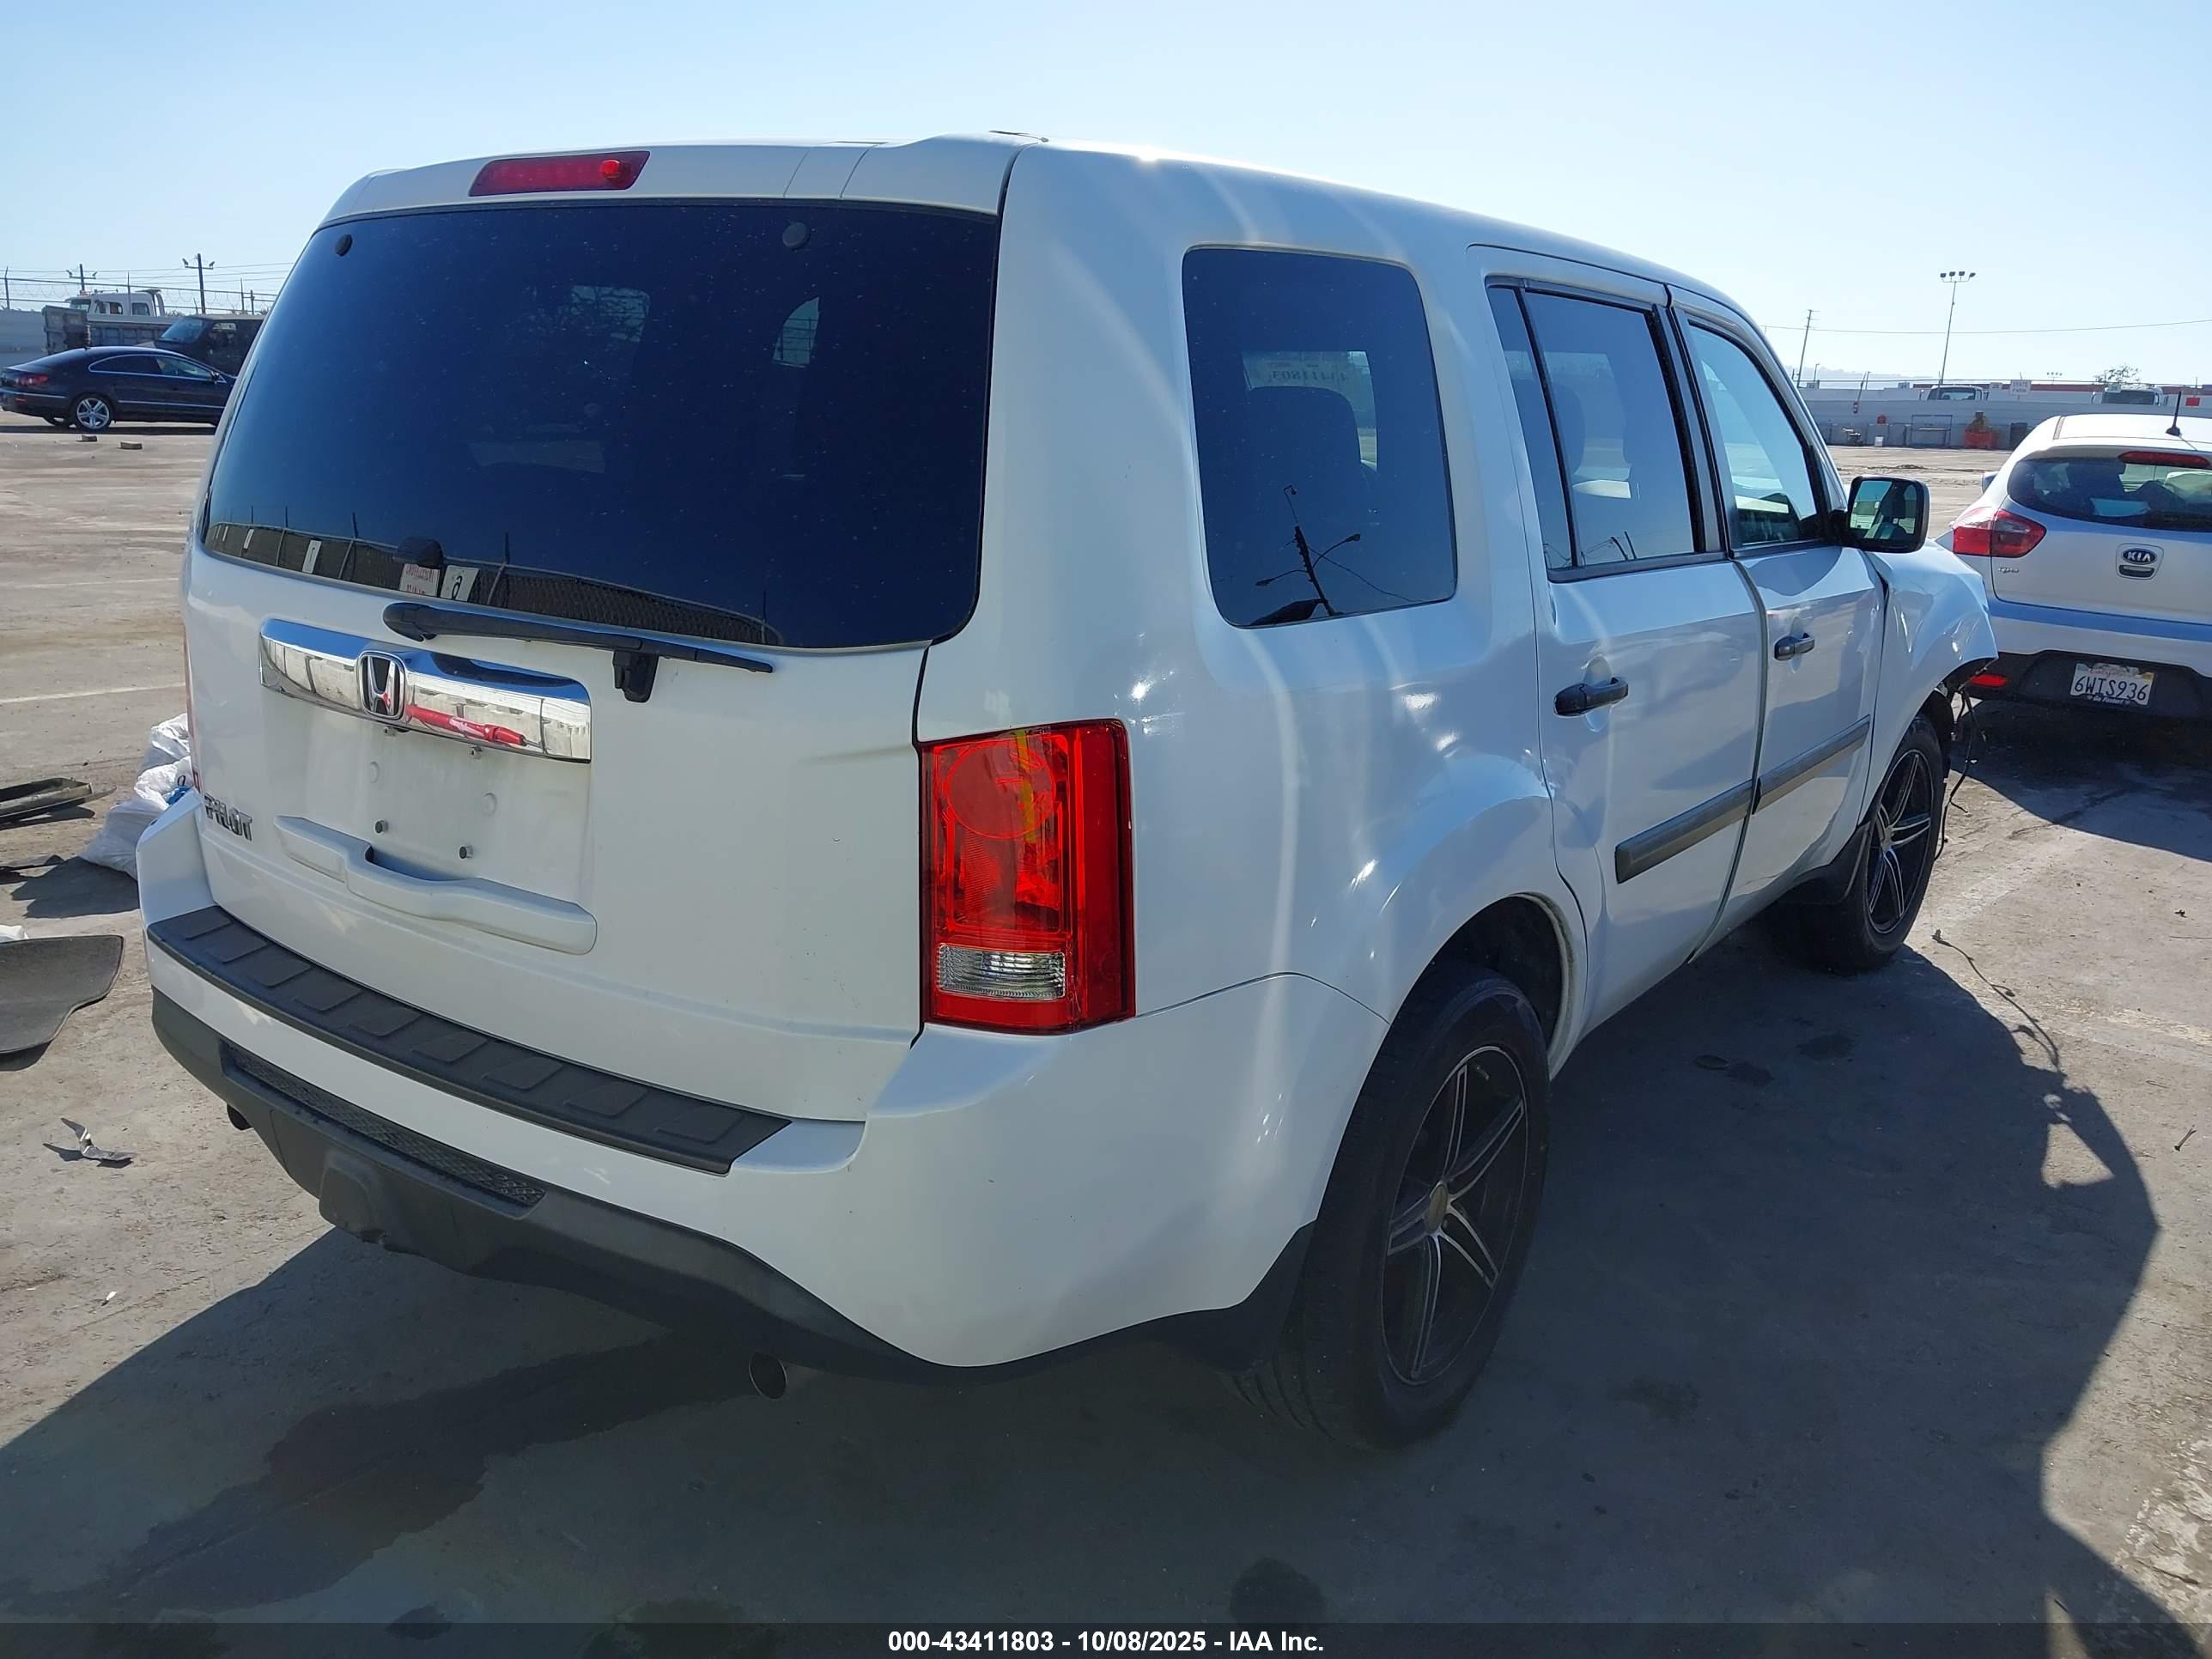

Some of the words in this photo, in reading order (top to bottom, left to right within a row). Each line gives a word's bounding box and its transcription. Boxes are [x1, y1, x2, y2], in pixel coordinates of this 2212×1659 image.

[2127, 550, 2151, 562] KIA
[2074, 675, 2149, 701] 6WIS936
[204, 792, 253, 842] PILOT
